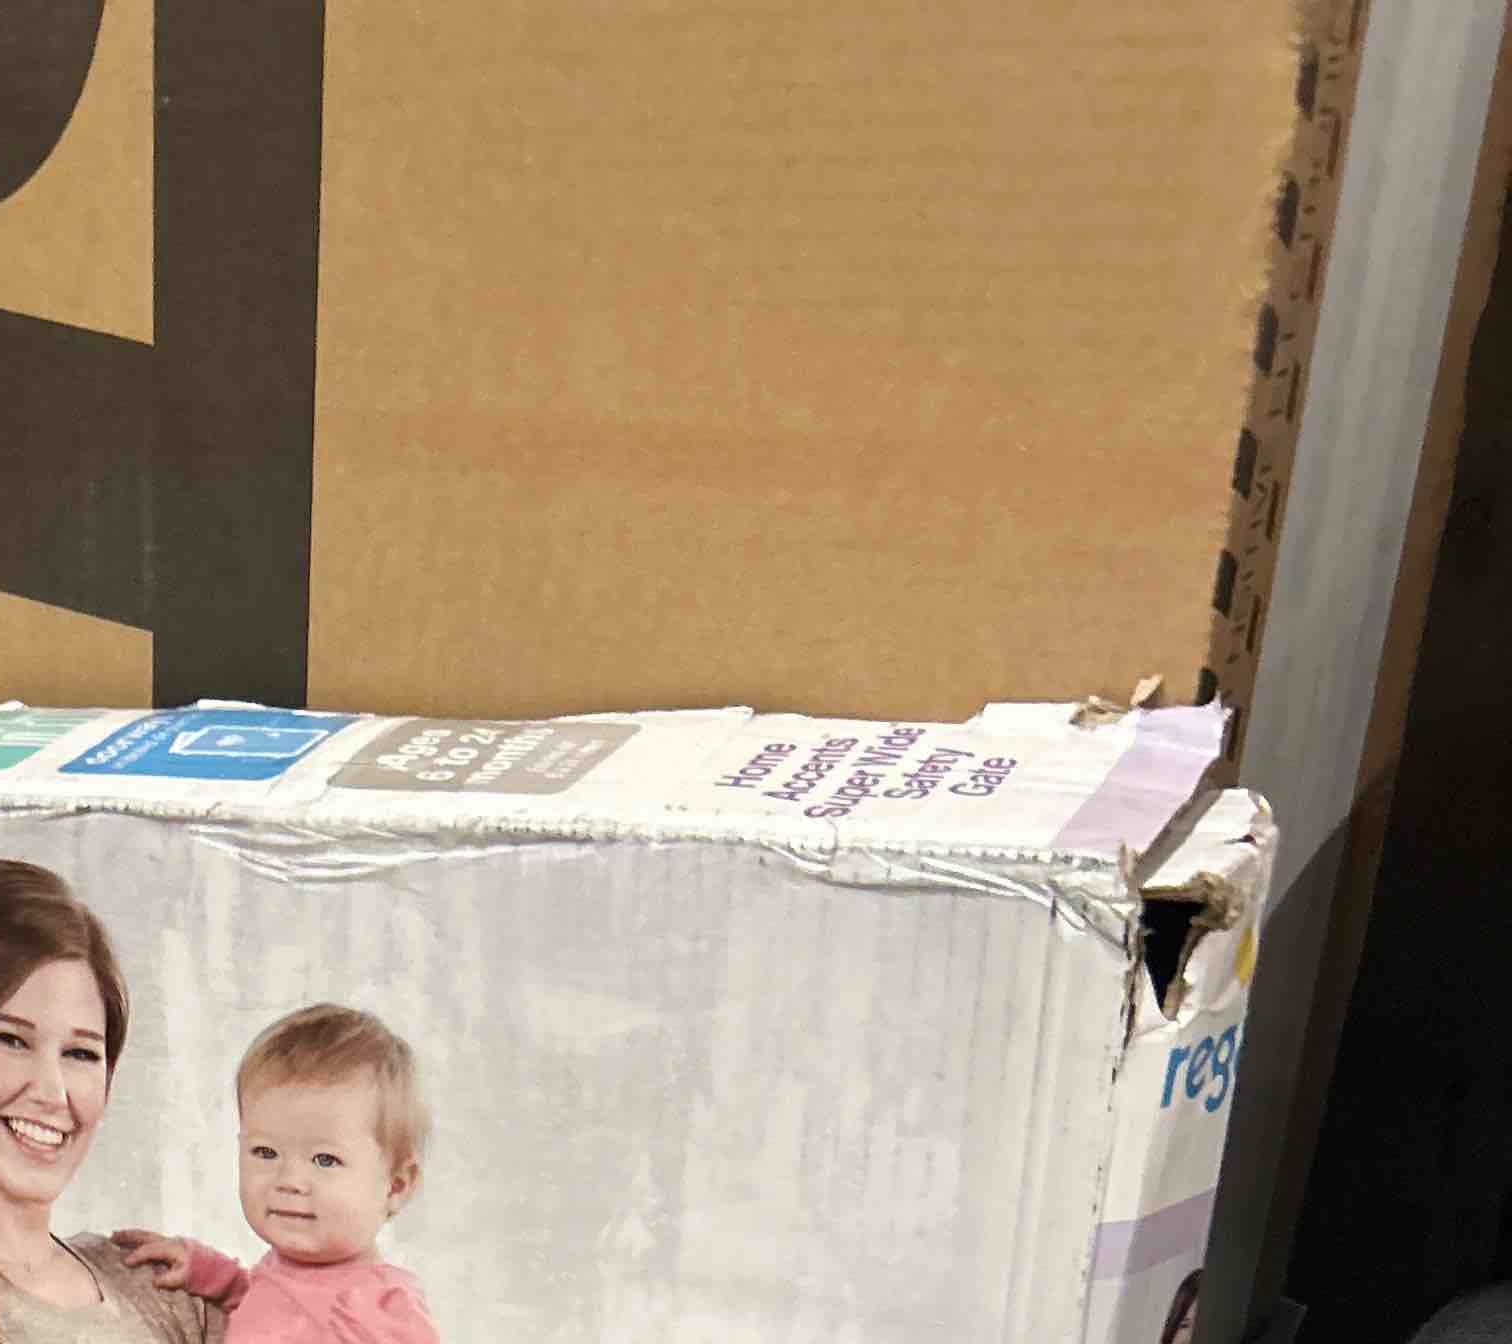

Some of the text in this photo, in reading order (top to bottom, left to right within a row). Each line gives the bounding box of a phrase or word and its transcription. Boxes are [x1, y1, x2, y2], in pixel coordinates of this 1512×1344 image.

[377, 729, 452, 771] Ages
[434, 747, 479, 766] to
[463, 728, 556, 785] months
[715, 743, 797, 787] Home
[762, 737, 859, 801] Accents
[804, 727, 927, 818] Super Wide
[883, 748, 975, 799] Safety
[949, 757, 1017, 797] Gate
